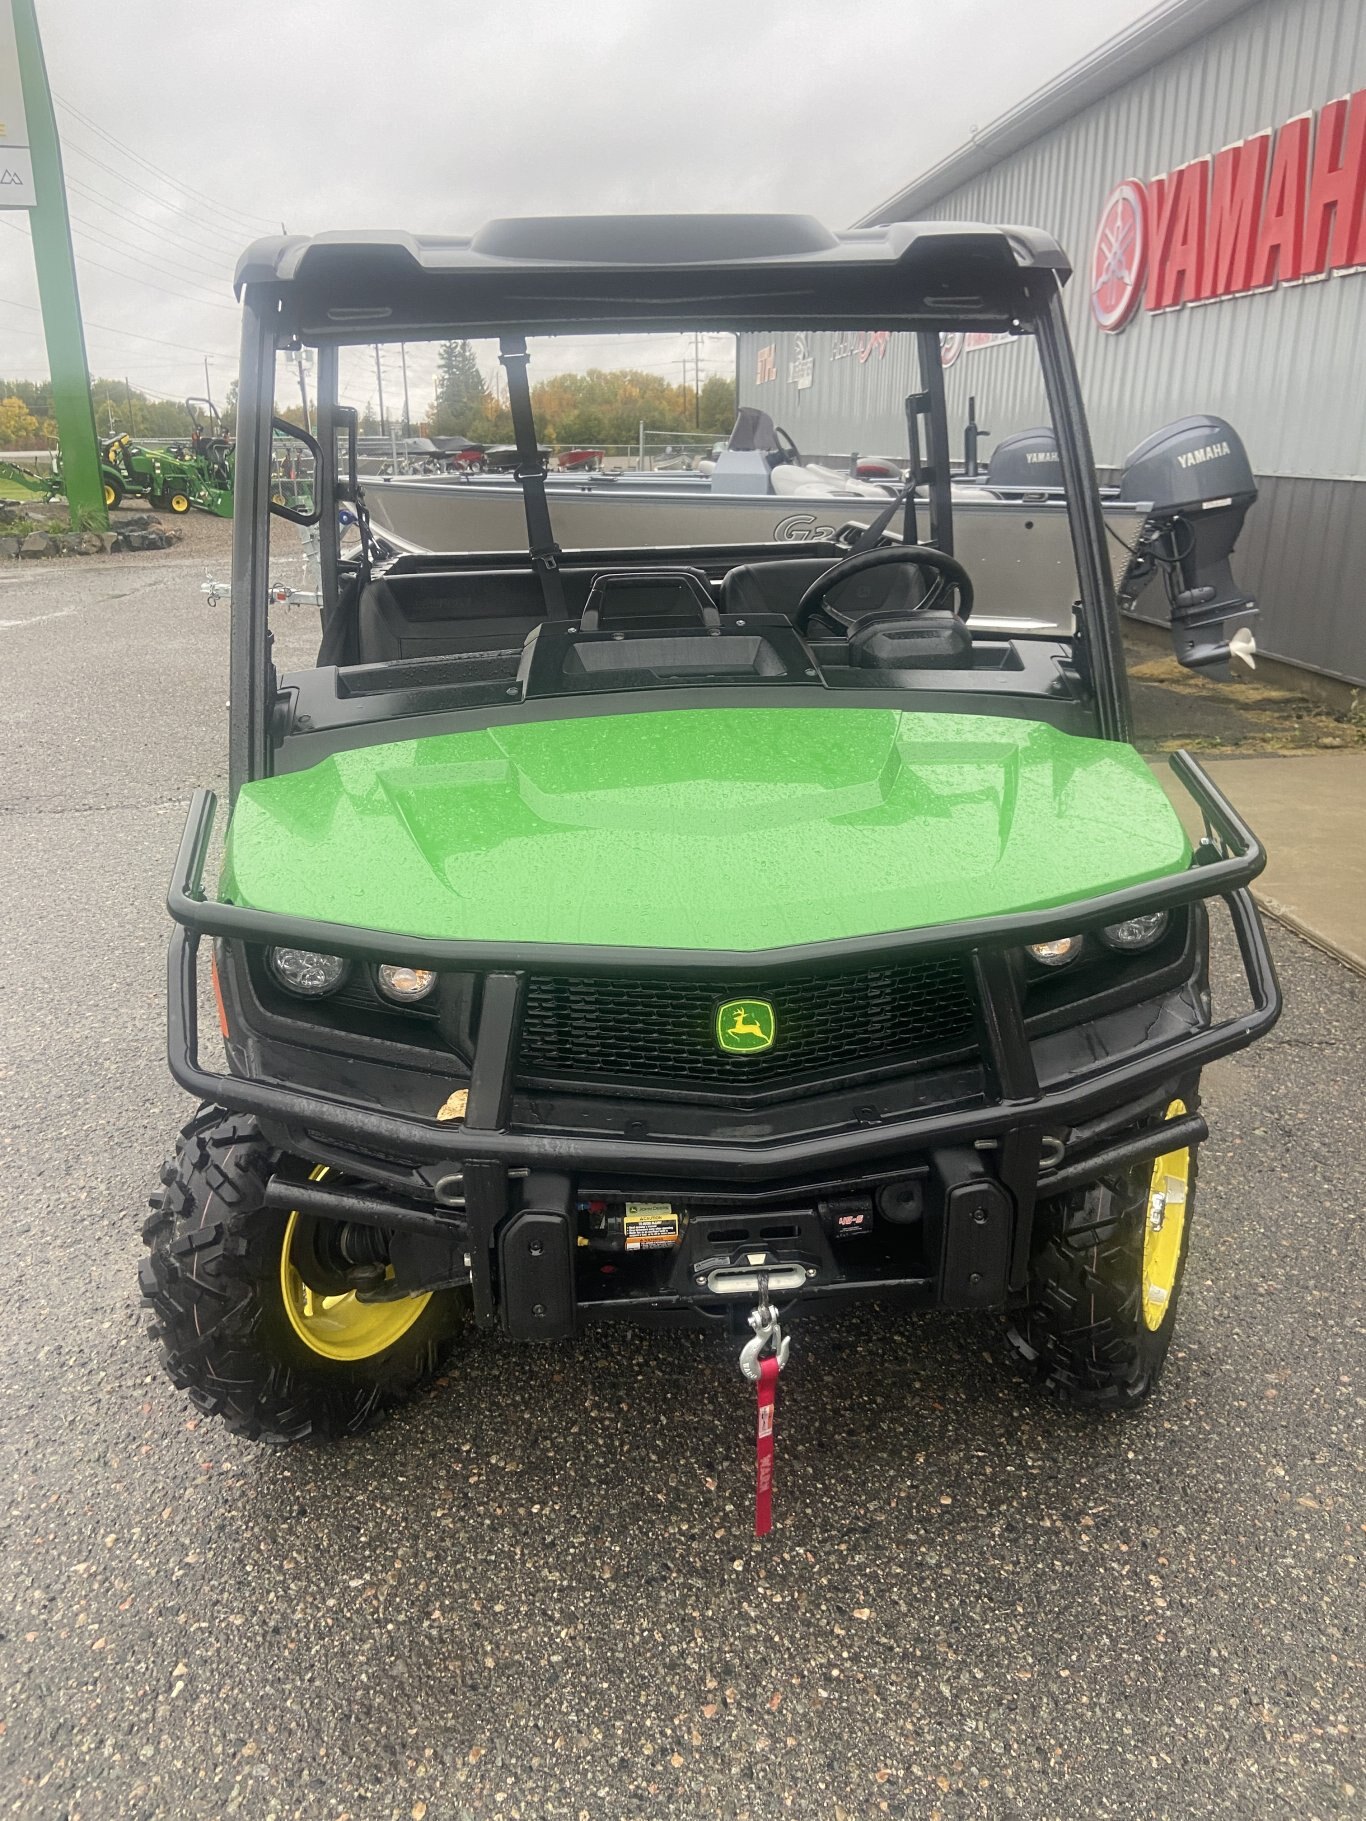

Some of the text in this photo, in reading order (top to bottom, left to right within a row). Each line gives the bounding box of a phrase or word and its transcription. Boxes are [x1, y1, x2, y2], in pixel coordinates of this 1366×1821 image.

[1145, 88, 1366, 314] YAMAH
[1026, 451, 1060, 464] YAMAH
[1177, 441, 1231, 469] YAMAHA
[759, 1453, 771, 1494] WARN
